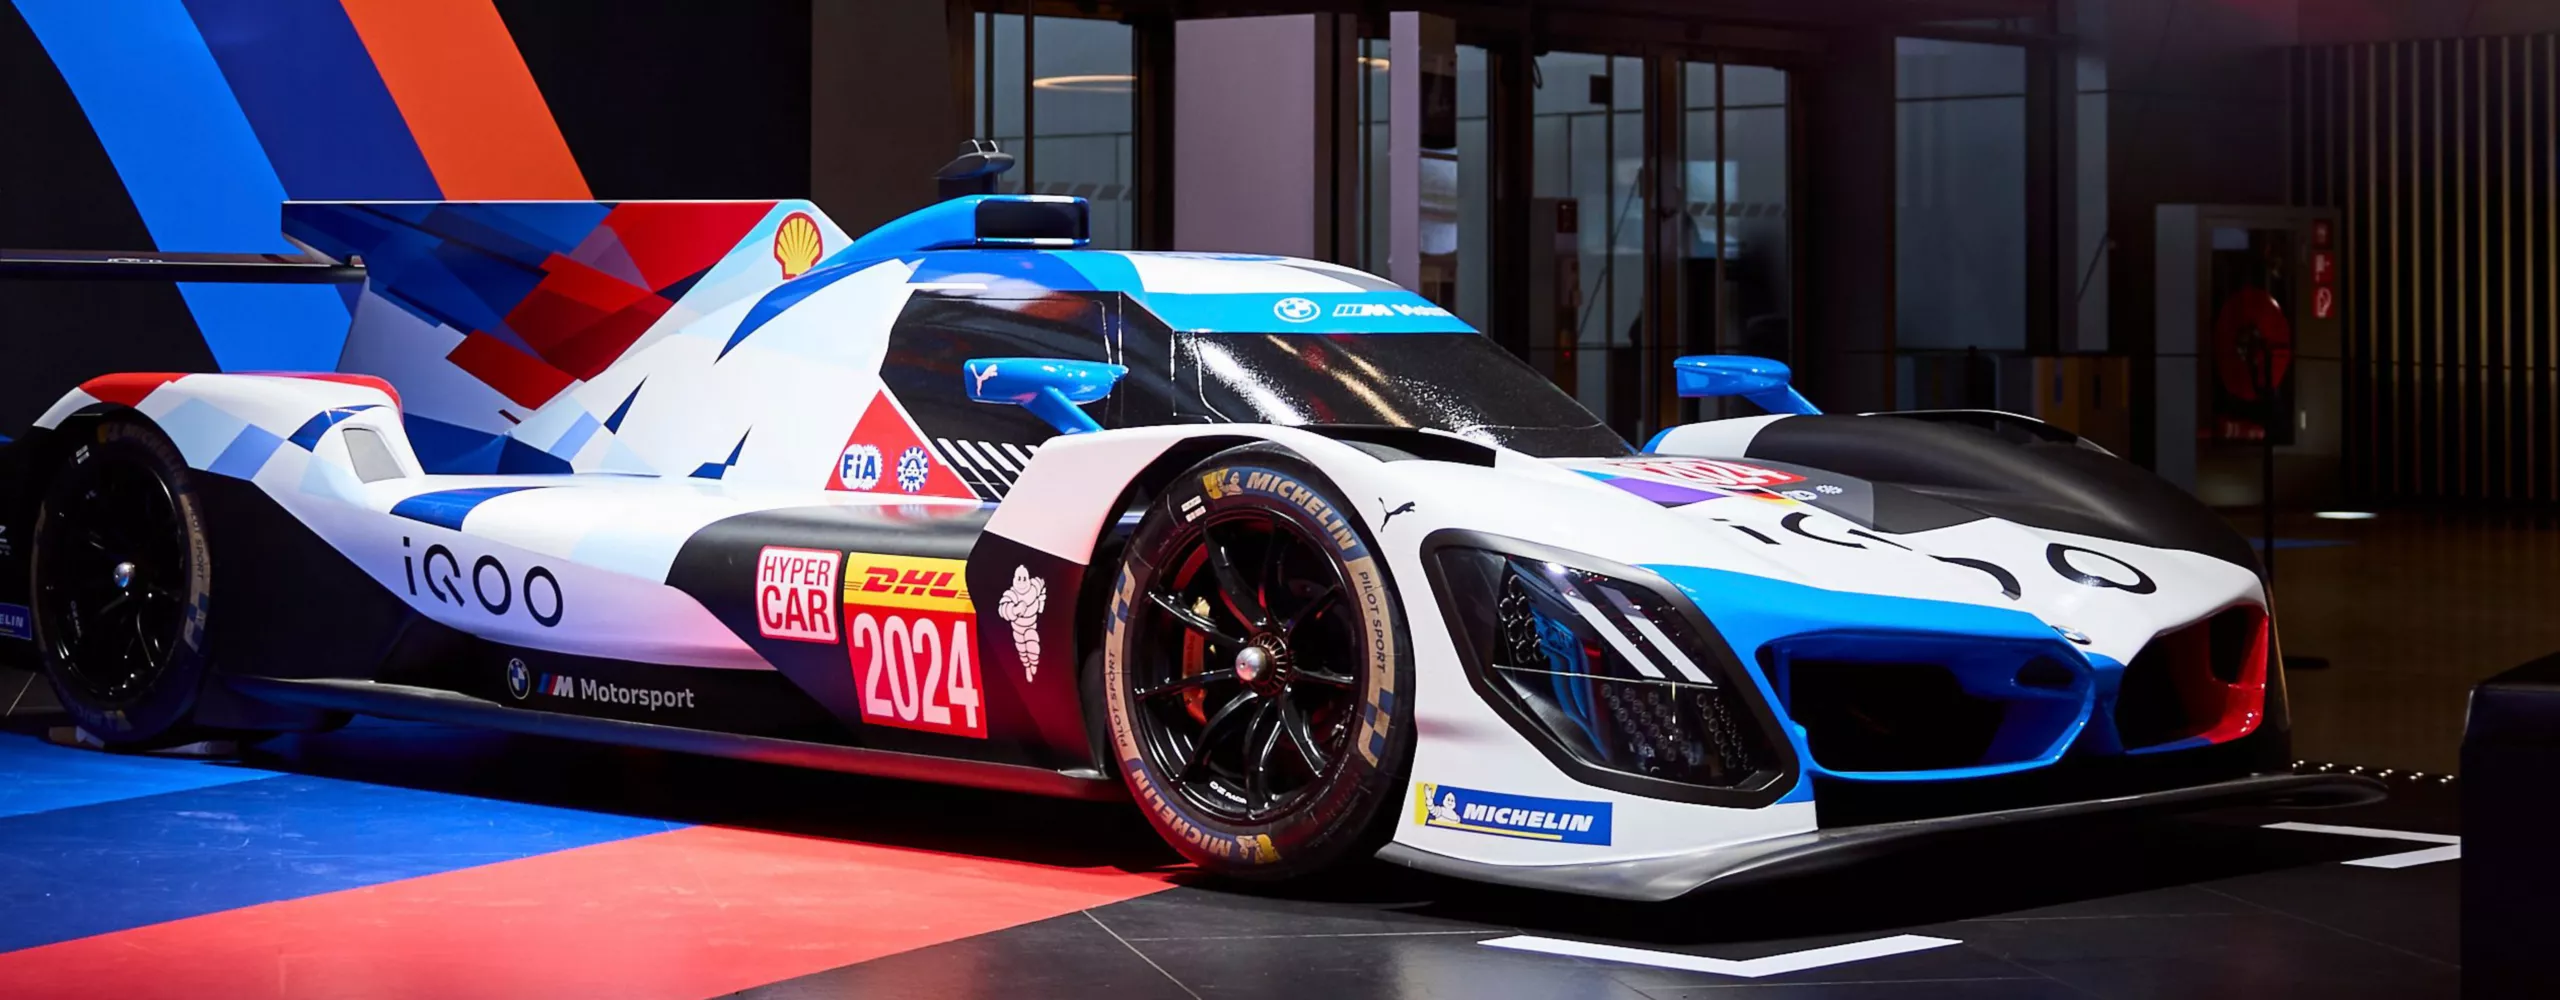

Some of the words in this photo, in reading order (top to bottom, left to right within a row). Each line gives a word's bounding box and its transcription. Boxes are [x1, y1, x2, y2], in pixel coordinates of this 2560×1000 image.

[1246, 472, 1357, 550] MICHELIN
[403, 536, 563, 628] iQOO
[762, 556, 831, 586] HYPER
[862, 566, 960, 599] DHL
[762, 585, 831, 633] CAR
[1358, 571, 1379, 614] PILOT
[1373, 619, 1386, 673] SPORT
[580, 678, 695, 711] Motorsport
[852, 612, 979, 728] 2024
[1108, 651, 1117, 701] SPORT
[1111, 708, 1128, 747] PILOT
[1131, 768, 1232, 857] MICHELIN
[1463, 803, 1594, 832] MICHELIN
